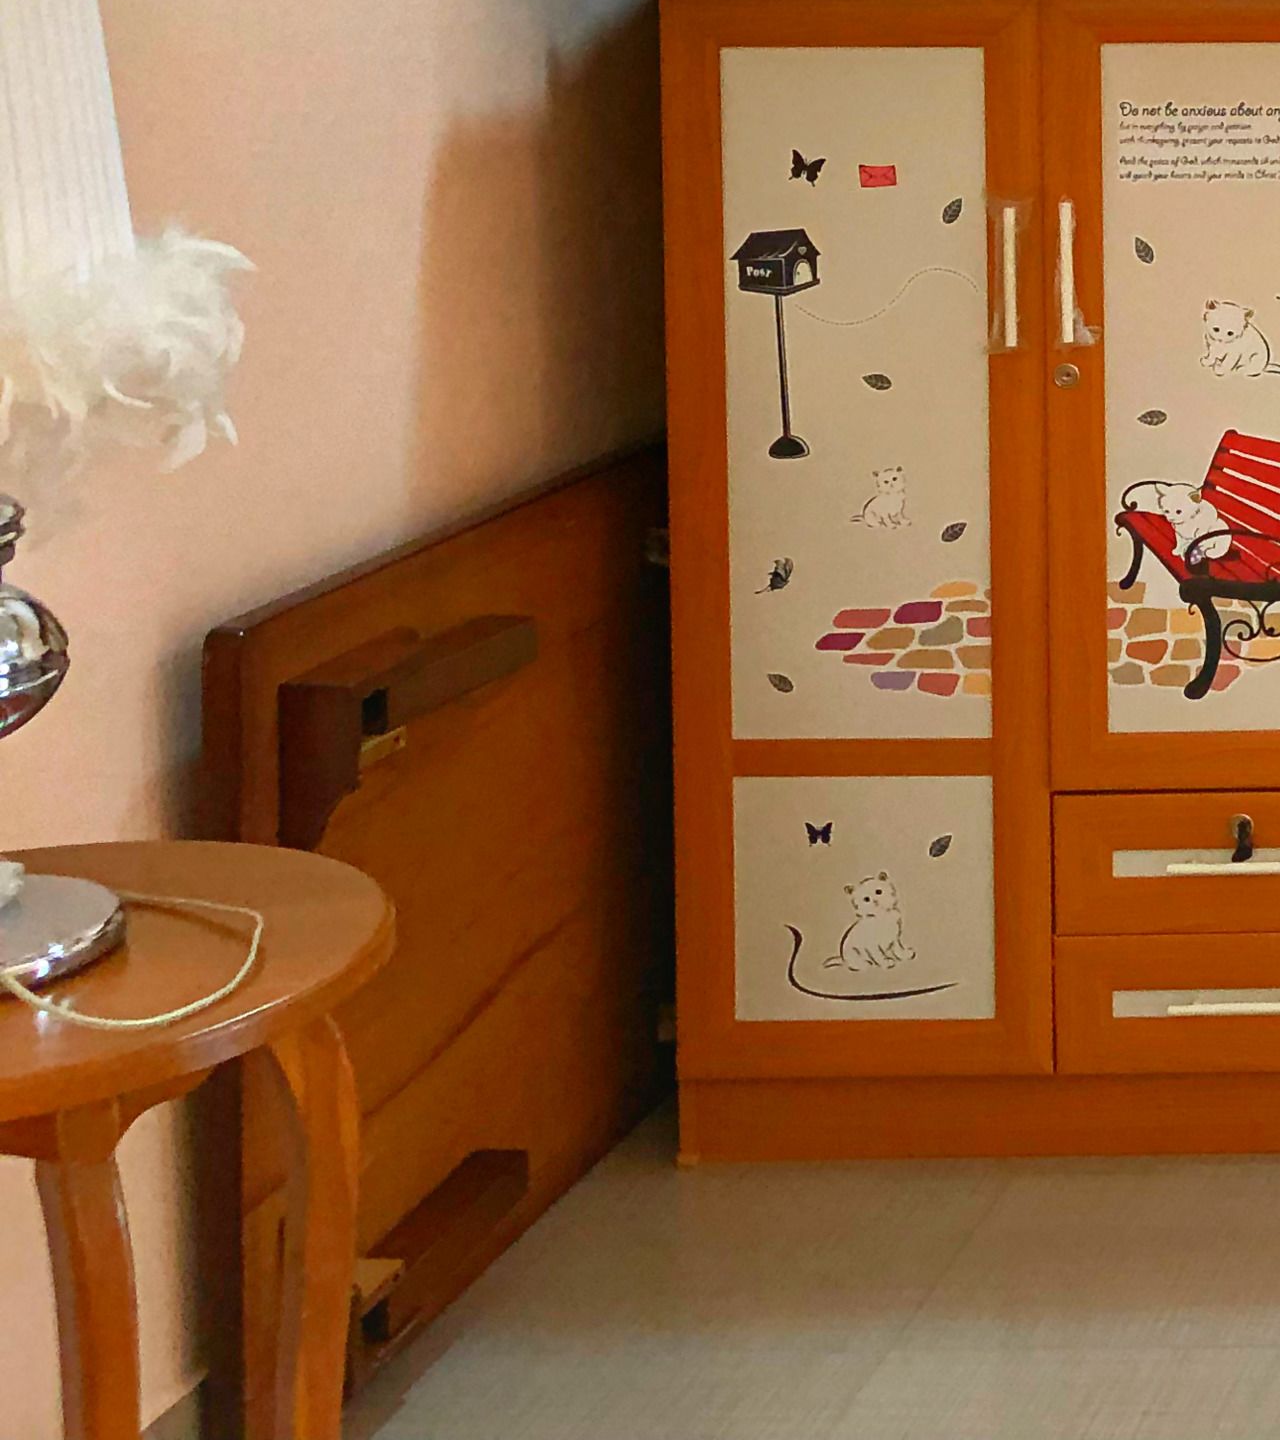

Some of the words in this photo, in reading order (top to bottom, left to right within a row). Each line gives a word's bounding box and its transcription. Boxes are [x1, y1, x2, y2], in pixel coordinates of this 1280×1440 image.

[1119, 101, 1139, 117] Do
[1142, 106, 1162, 117] not
[1164, 101, 1178, 117] be
[1181, 106, 1226, 117] anxious
[1229, 101, 1263, 117] about
